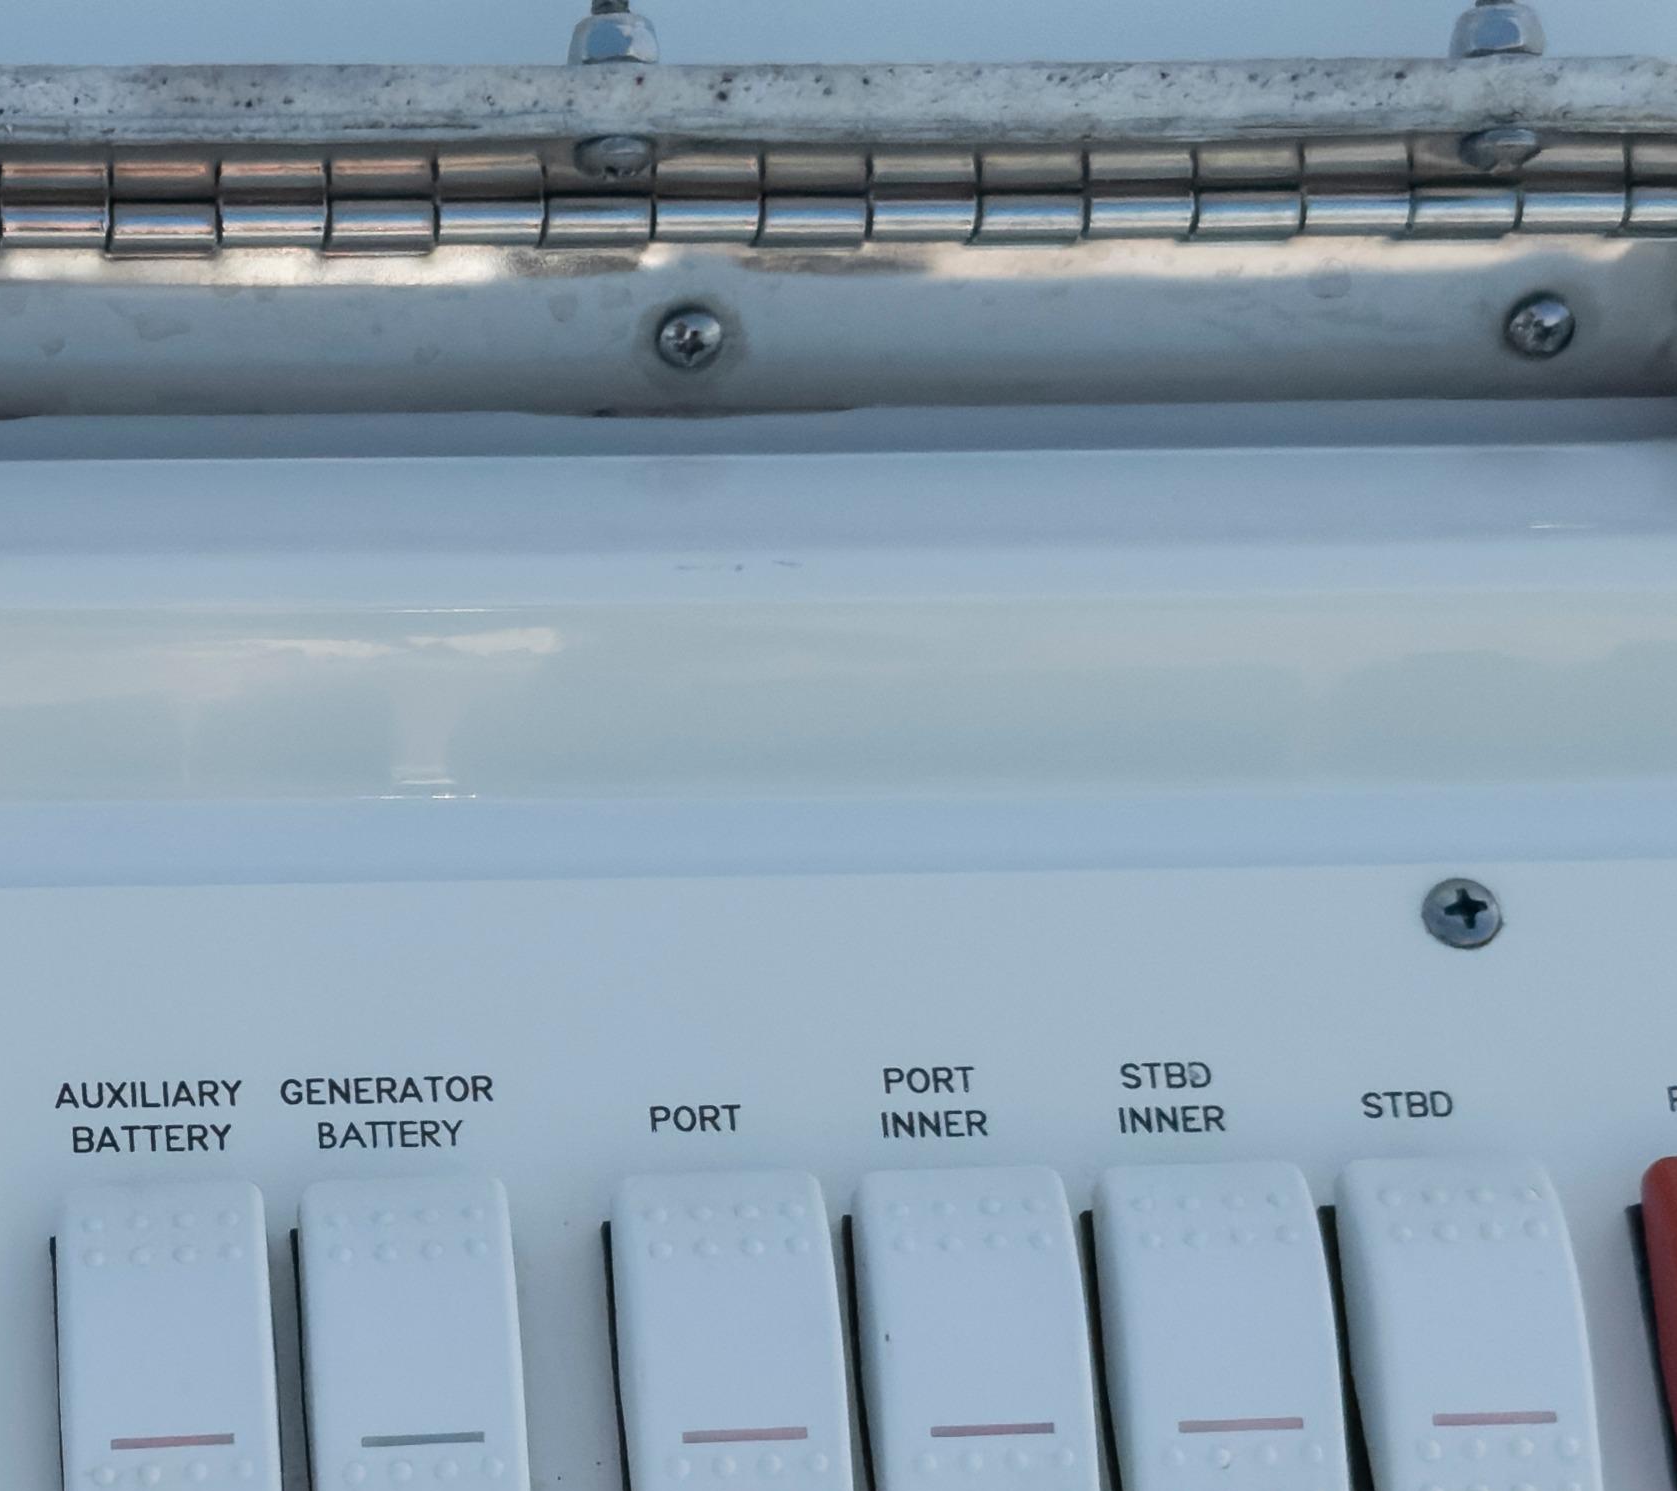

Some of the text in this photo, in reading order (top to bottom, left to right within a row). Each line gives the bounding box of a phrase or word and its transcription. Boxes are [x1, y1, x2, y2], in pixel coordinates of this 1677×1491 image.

[279, 1074, 495, 1107] GENERATOR
[881, 1065, 976, 1096] PORT
[1119, 1060, 1213, 1091] STBD
[53, 1078, 243, 1110] AUXILIARY
[1360, 1089, 1454, 1120] STBD
[648, 1103, 742, 1134] PORT
[880, 1108, 989, 1140] INNER
[1117, 1104, 1227, 1135] INNER
[71, 1122, 233, 1155] BATTERY
[316, 1118, 464, 1151] BATTERY
